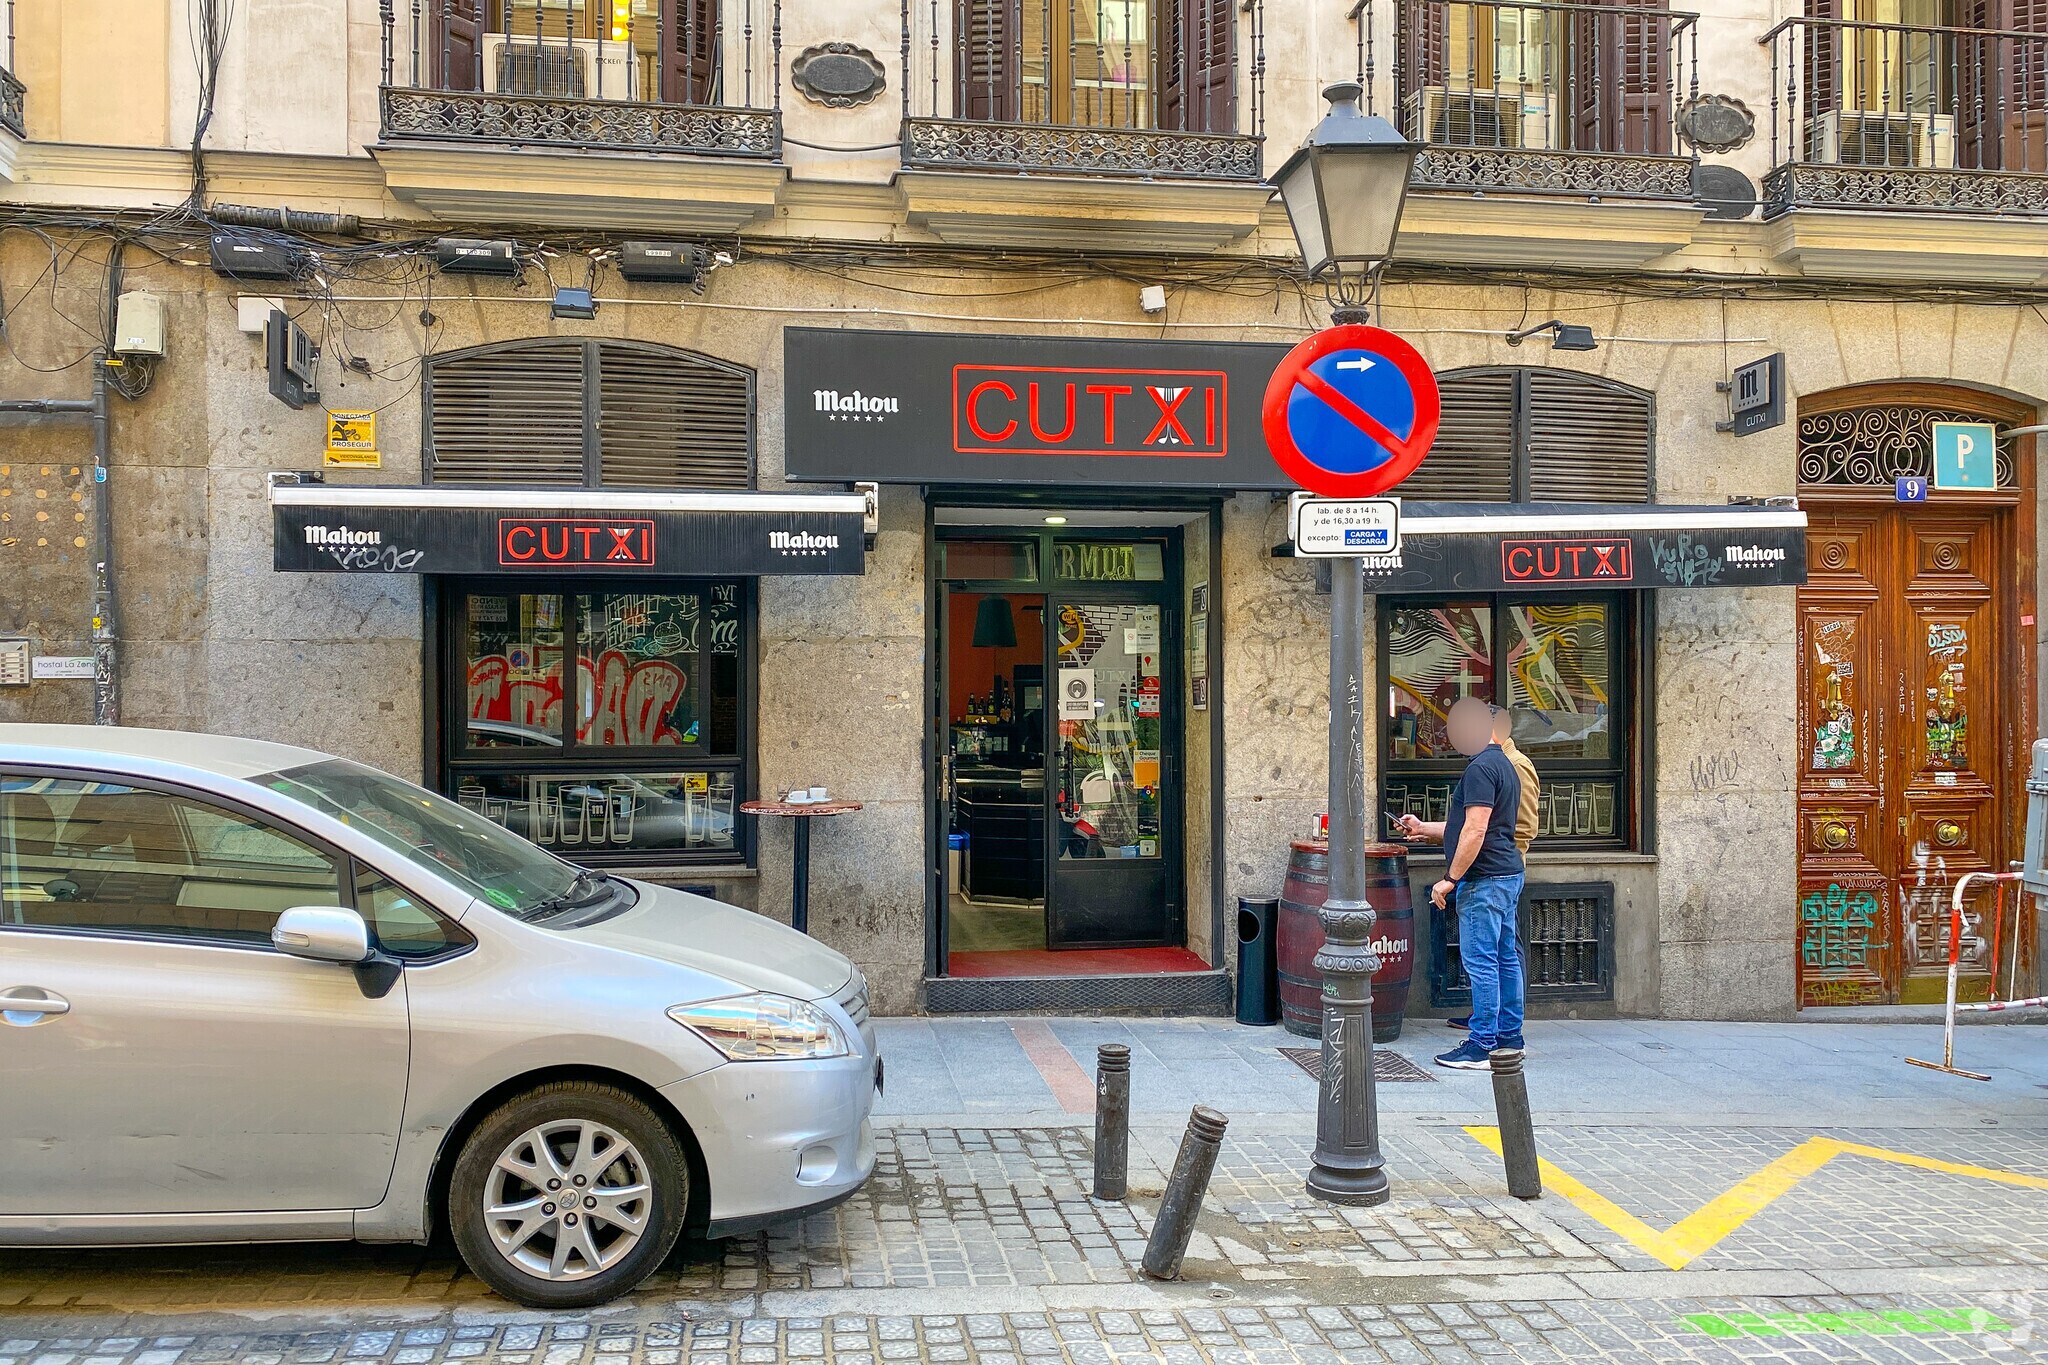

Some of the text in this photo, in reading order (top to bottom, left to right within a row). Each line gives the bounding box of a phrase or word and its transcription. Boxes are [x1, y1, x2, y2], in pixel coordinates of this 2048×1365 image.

[812, 388, 899, 414] Mahou
[965, 380, 1215, 446] CUTXI
[1746, 412, 1766, 427] CUTXI
[1957, 434, 1974, 469] P
[1906, 480, 1920, 499] 9
[1317, 507, 1332, 515] lab.
[1333, 507, 1344, 515] de
[303, 525, 382, 545] Mahou
[505, 526, 648, 560] CUTXI
[768, 530, 839, 549] Mahou
[1307, 534, 1342, 542] excepto:
[1508, 546, 1627, 577] CUTXI
[1725, 544, 1786, 563] Mahou
[1095, 670, 1133, 682] UTXI
[1366, 935, 1408, 955] ahou
